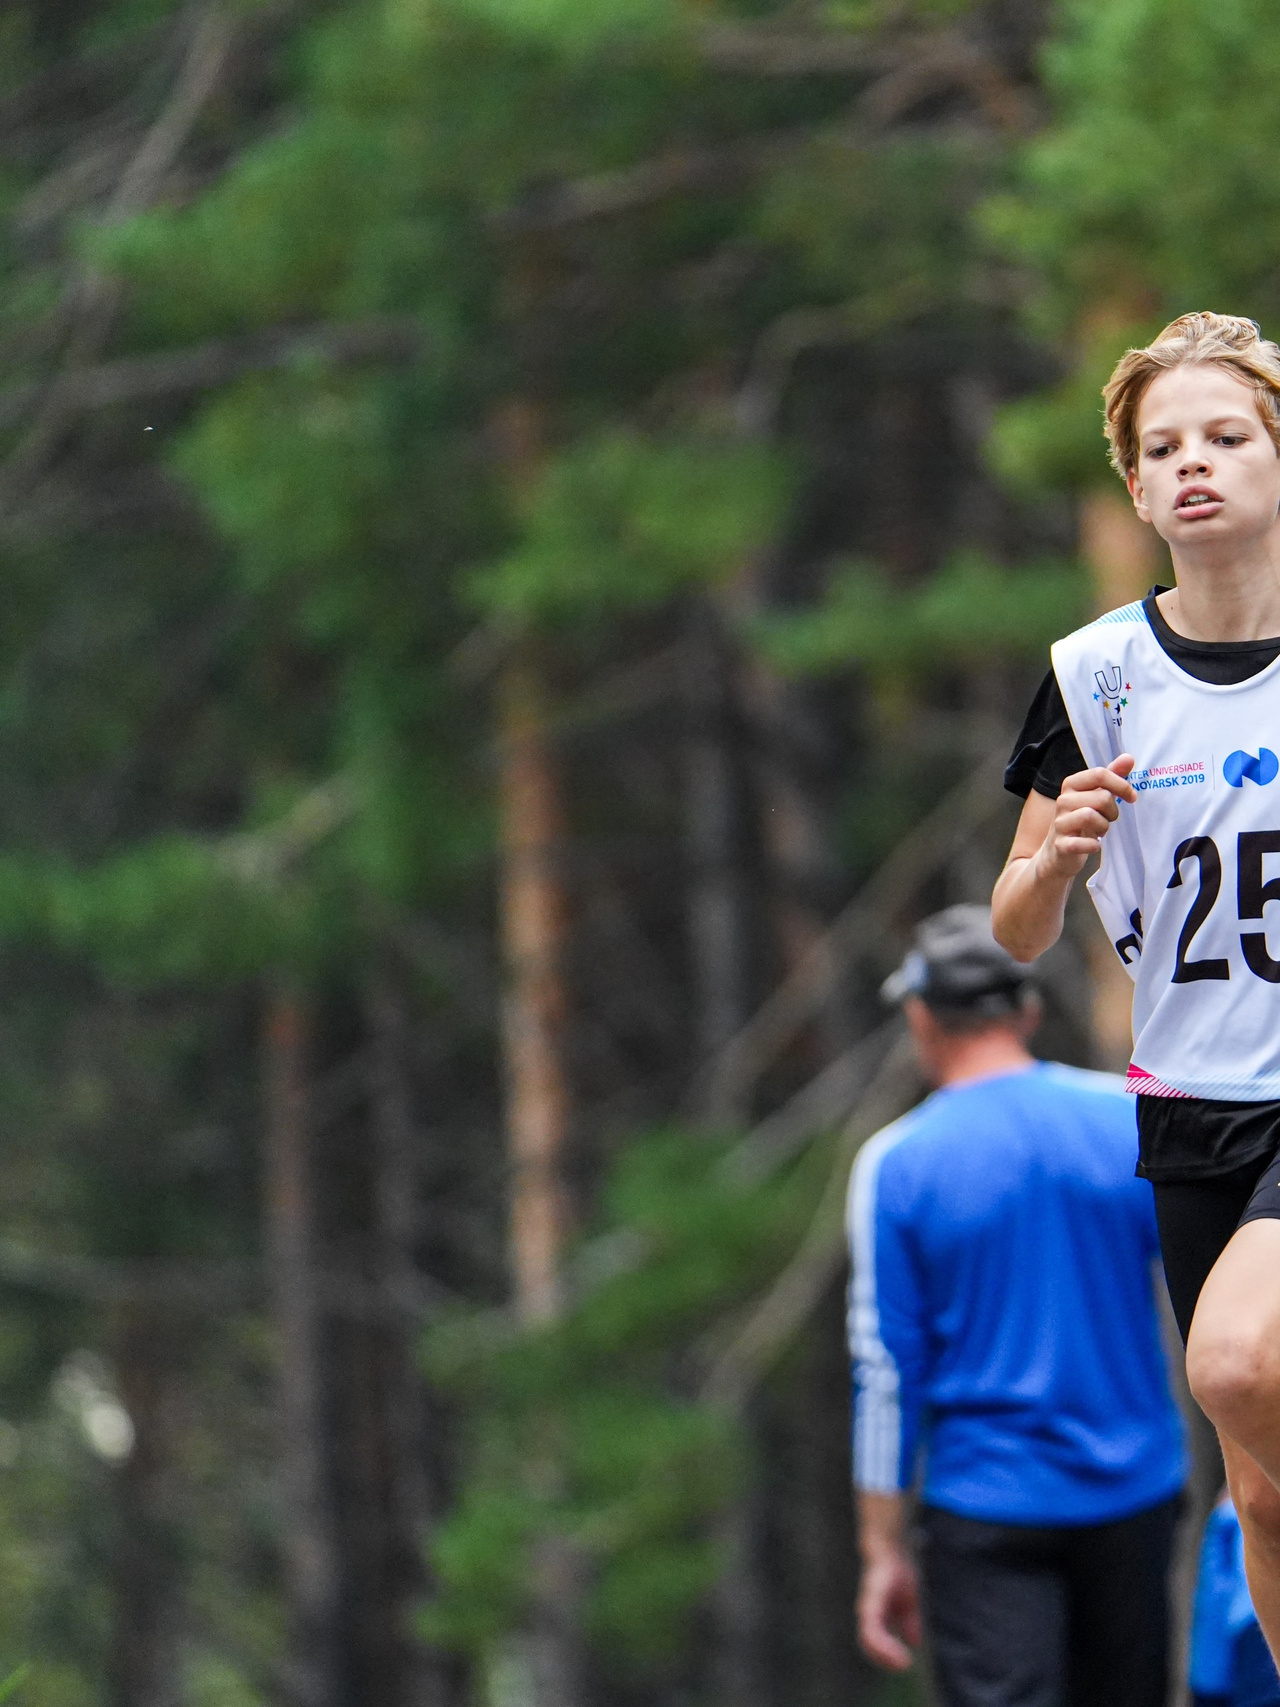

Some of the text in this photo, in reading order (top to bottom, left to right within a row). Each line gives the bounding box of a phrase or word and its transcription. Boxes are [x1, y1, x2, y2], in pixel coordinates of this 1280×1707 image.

[1149, 762, 1204, 776] UNIVERSIADE
[1132, 773, 1205, 791] NOYARSK 2019
